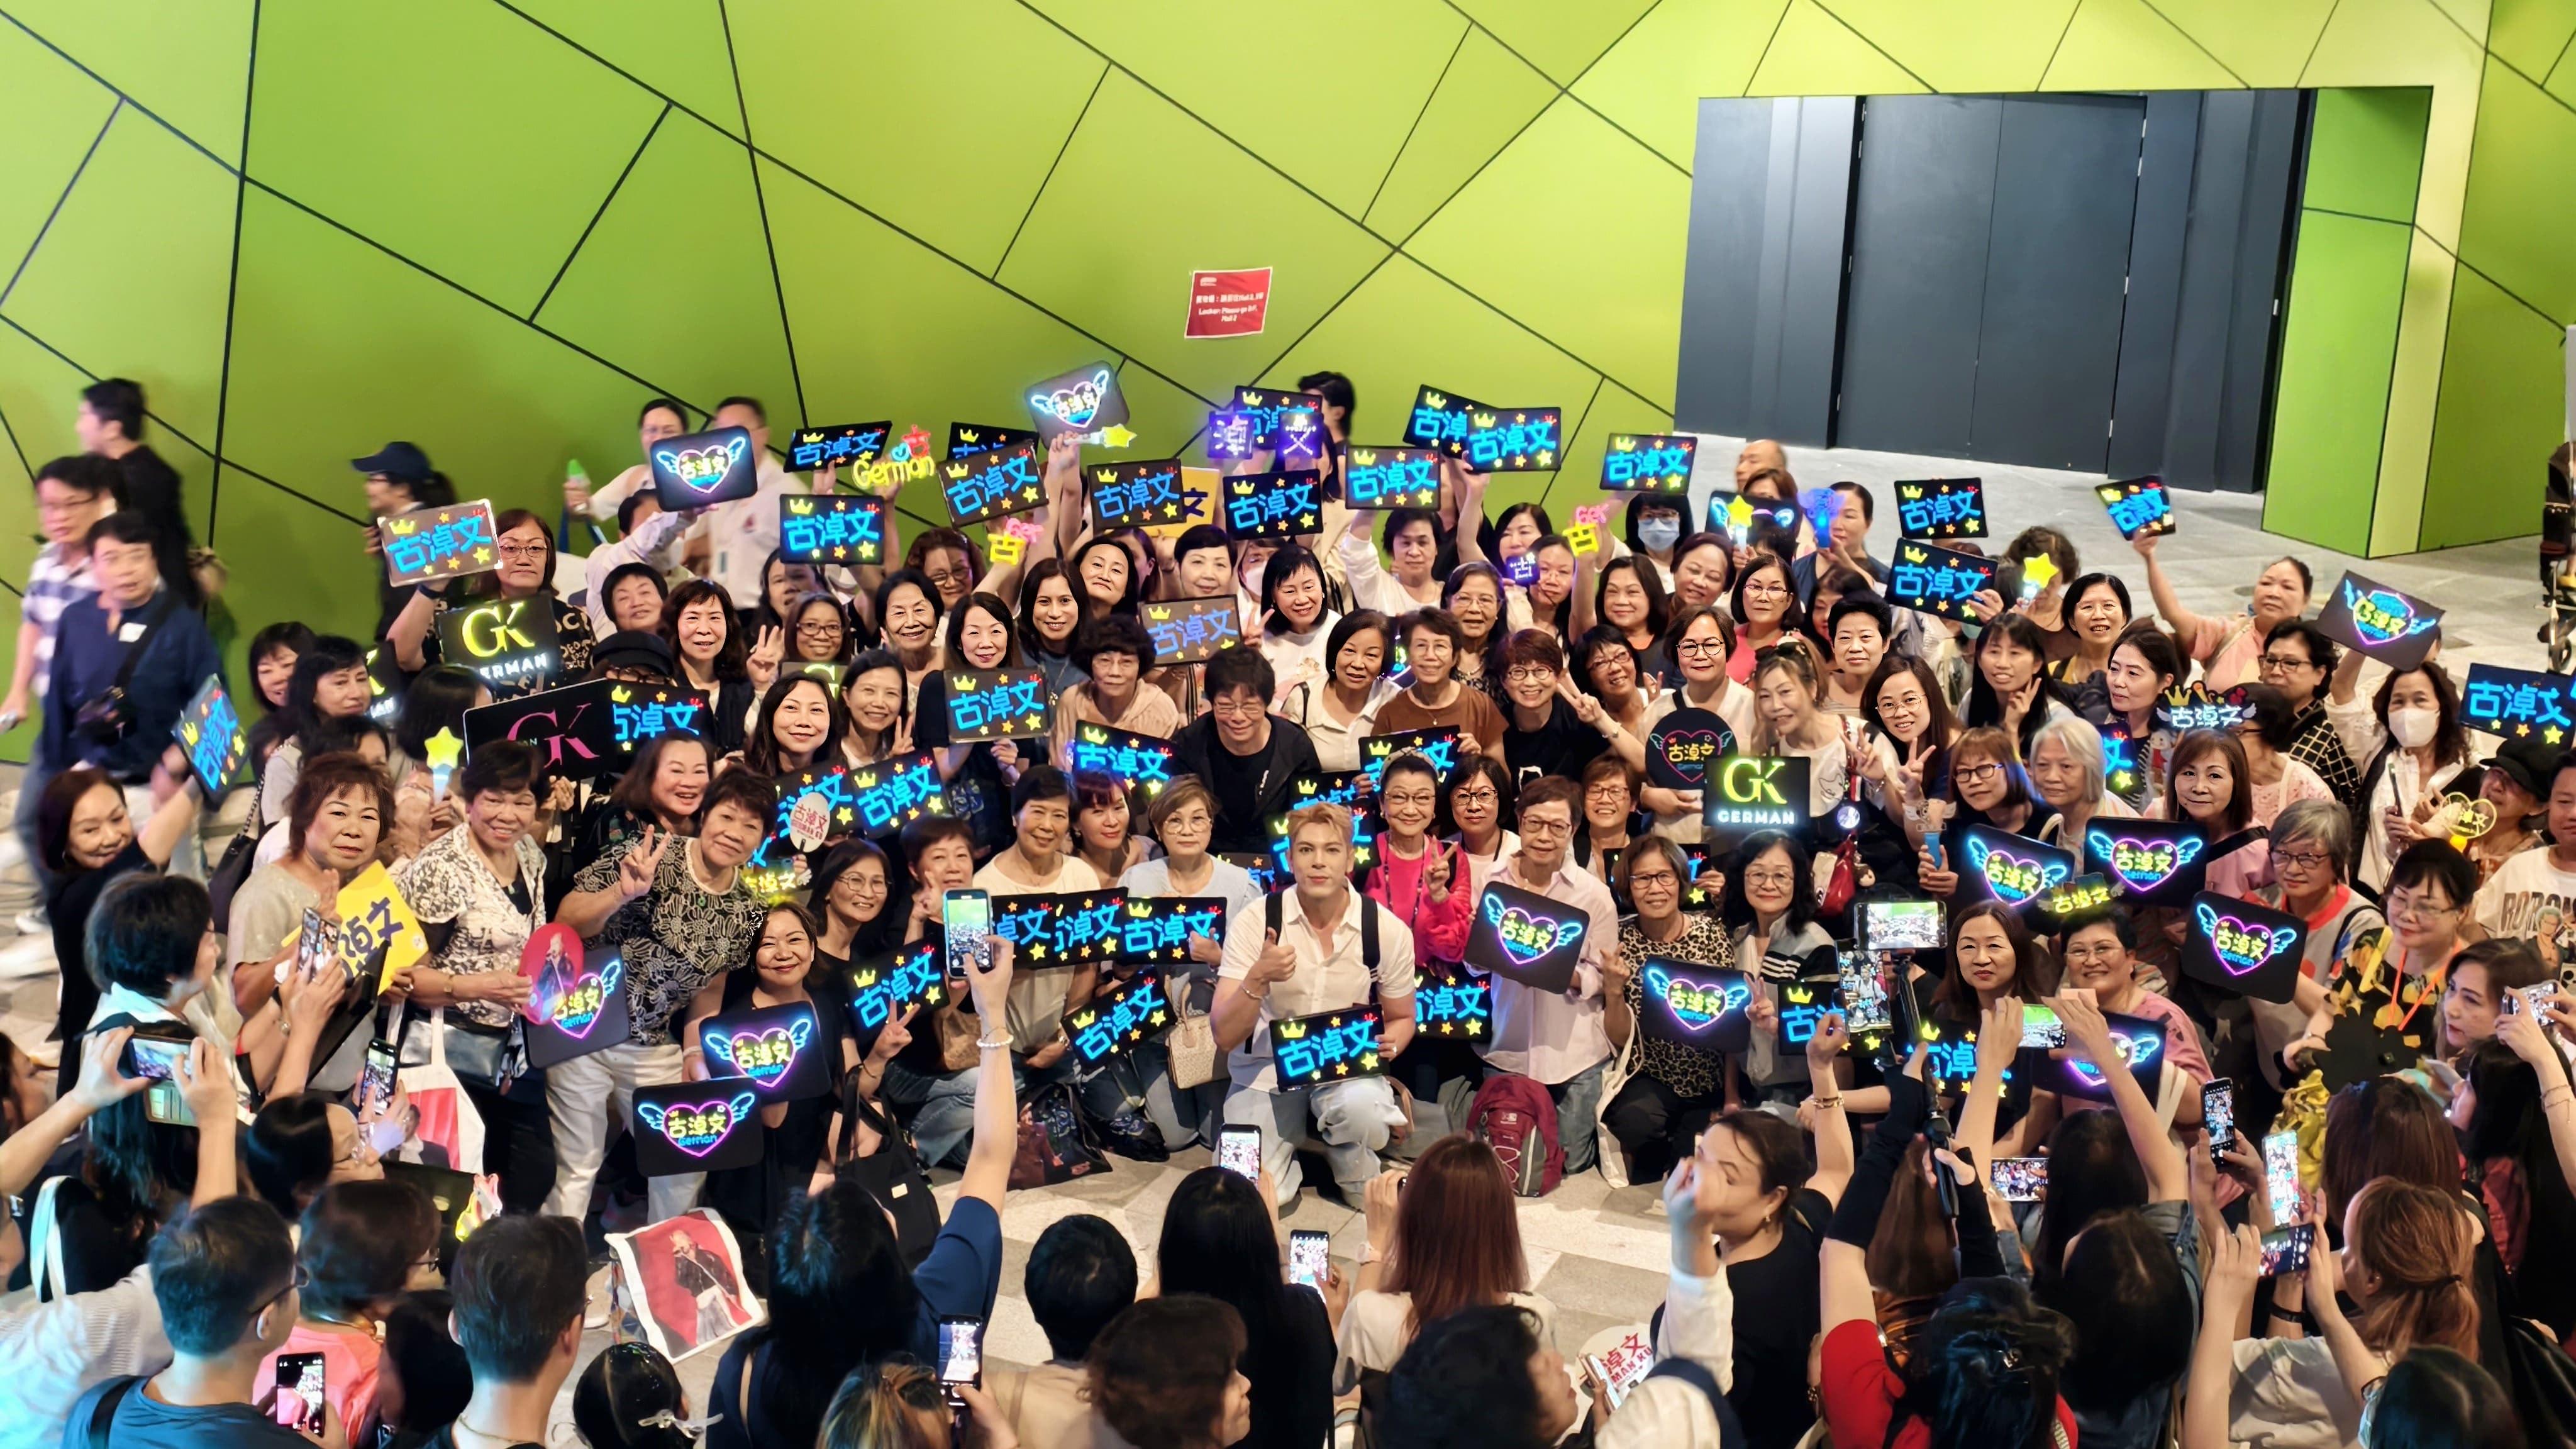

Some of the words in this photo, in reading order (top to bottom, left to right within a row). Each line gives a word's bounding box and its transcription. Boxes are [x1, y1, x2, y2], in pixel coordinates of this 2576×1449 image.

[794, 431, 880, 465] 古淖文
[1468, 419, 1556, 464] 古淖文
[852, 454, 935, 489] German
[1349, 458, 1437, 499] 古淖文
[1607, 446, 1689, 482] 古淖文
[947, 455, 1038, 515] 古淖文
[1094, 472, 1180, 518] 古淖文
[1230, 484, 1318, 529] 古淖文
[1901, 491, 1981, 530] 古淖文
[387, 515, 492, 574] 古淖文
[784, 508, 879, 551] 古淖文
[987, 531, 1026, 565] 古
[1562, 521, 1599, 558] 古
[1895, 564, 1985, 601] 古淖文
[1150, 609, 1237, 655] 古淖文
[950, 680, 1045, 731] 古淖文
[2172, 706, 2243, 728] 古淖文
[2469, 682, 2570, 726] 古淖文
[1077, 742, 1169, 780] 古淖文
[857, 764, 941, 827] 古淖文
[1724, 758, 1787, 804] GK
[792, 803, 828, 831] 古淖文
[1718, 810, 1795, 824] GERMAN
[1987, 862, 2038, 894] 古淖文
[2116, 848, 2172, 872] 古淖文
[2053, 887, 2111, 914] 古淖文
[1124, 911, 1219, 953] 古淖文
[1502, 919, 1552, 951] 古淖文
[2216, 928, 2267, 960] 古淖文
[854, 953, 941, 1028] 古淖文
[1670, 989, 1721, 1016] 古淖文
[1076, 984, 1165, 1060] 古淖文
[736, 1040, 791, 1069] 古淖文
[1279, 1020, 1379, 1077] 古淖文
[669, 1112, 726, 1137] 古淖文
